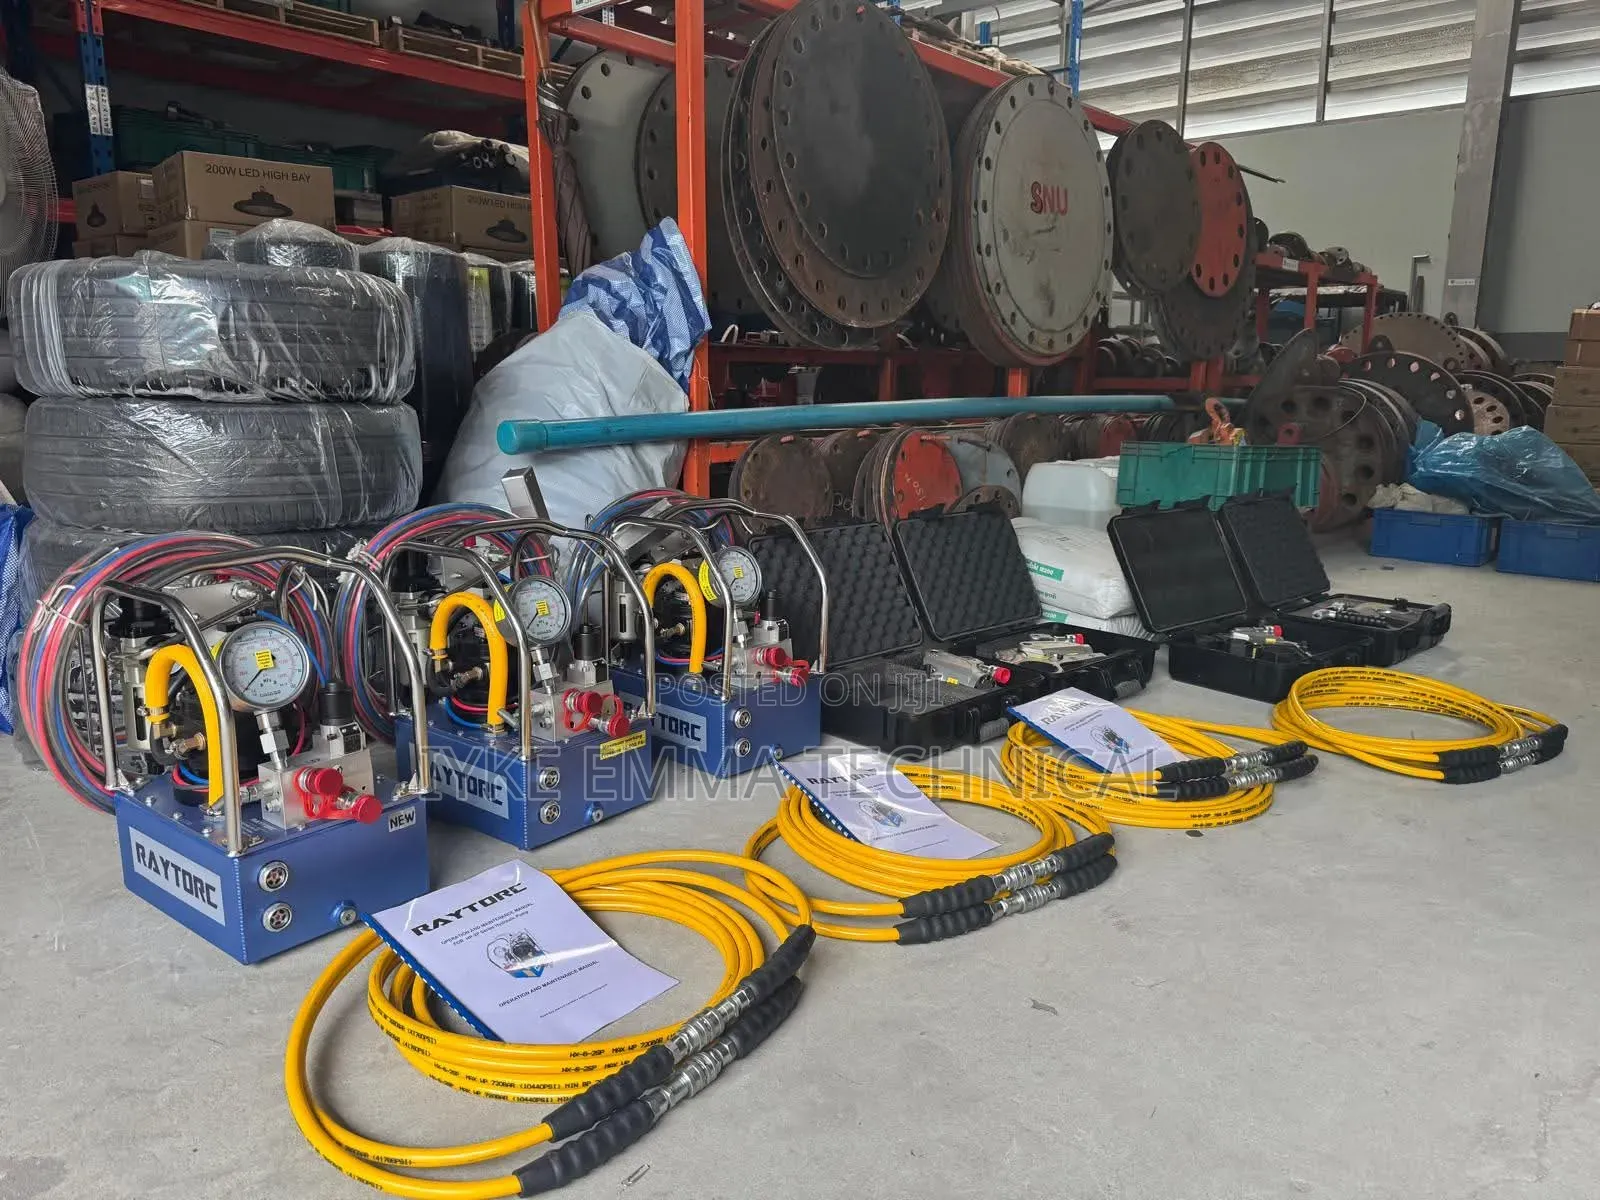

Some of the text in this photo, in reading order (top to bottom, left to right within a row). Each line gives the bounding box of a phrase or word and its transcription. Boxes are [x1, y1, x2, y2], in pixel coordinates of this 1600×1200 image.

[206, 163, 311, 183] 200W LED HIGH BAY
[1030, 181, 1068, 216] SNU
[390, 810, 415, 829] NEW
[135, 842, 218, 909] RAYTORC
[410, 883, 528, 936] RAYTORC
[498, 990, 530, 1008] OPERATION
[530, 985, 542, 994] AND
[541, 968, 579, 988] MAINTENANCE
[578, 960, 600, 972] MANUAL
[612, 1046, 625, 1054] MAX
[564, 1081, 579, 1089] MIN
